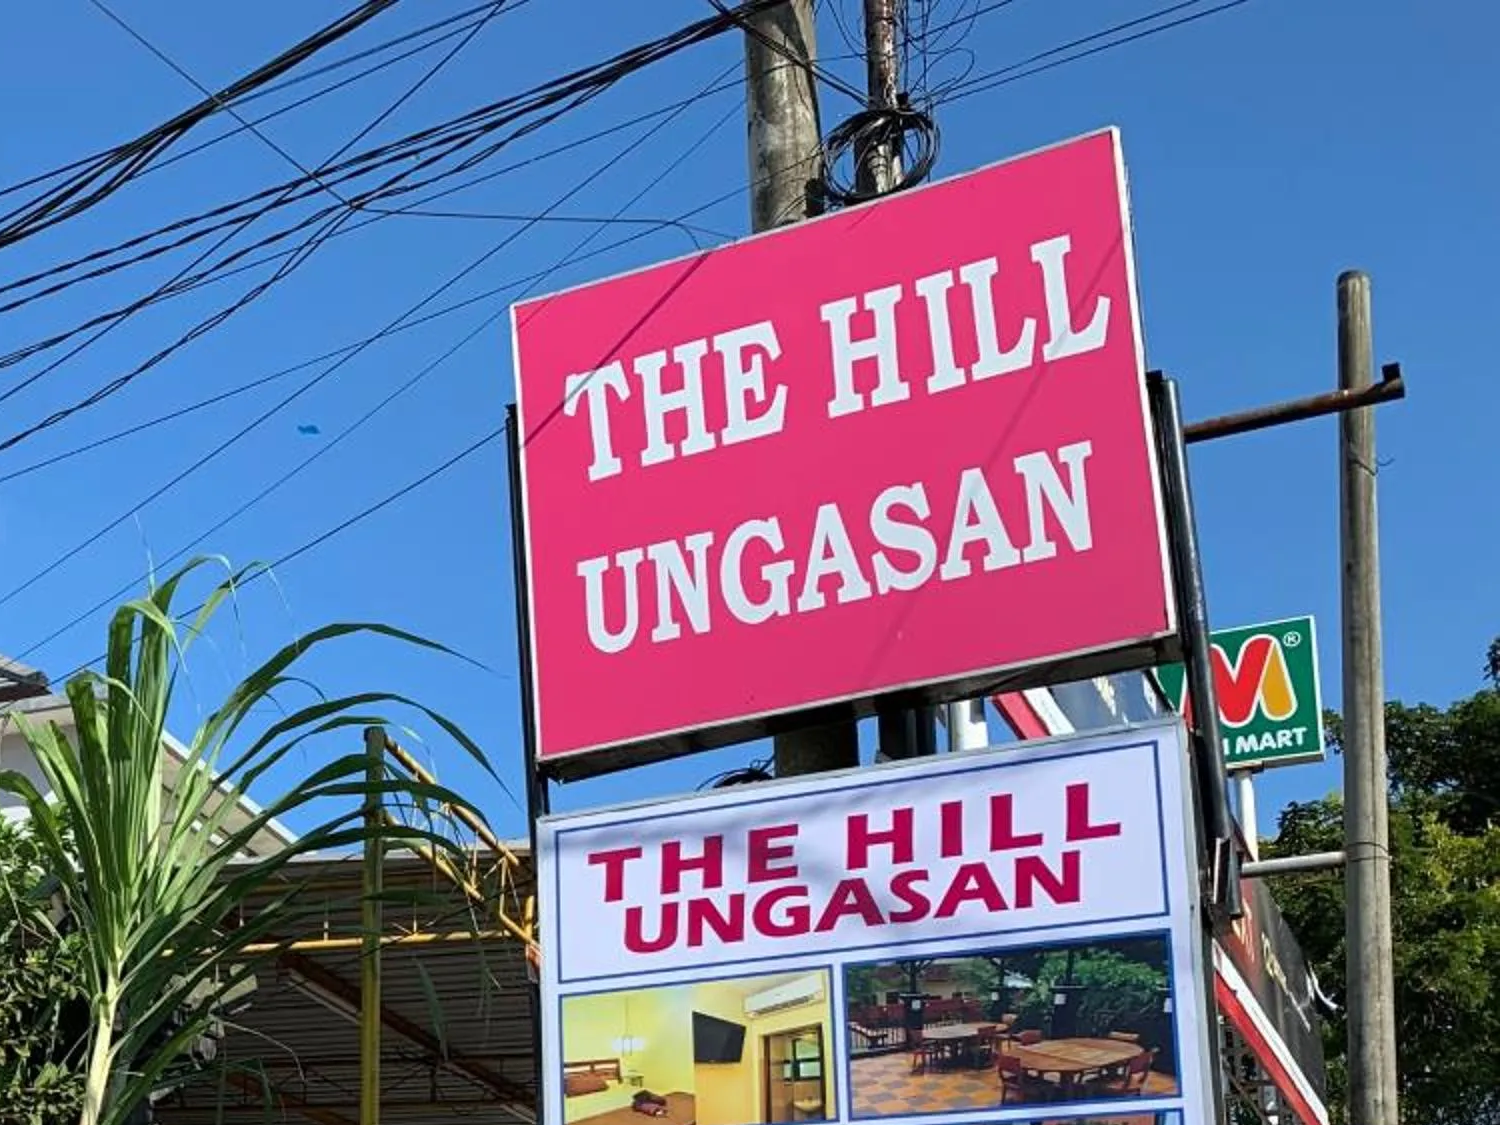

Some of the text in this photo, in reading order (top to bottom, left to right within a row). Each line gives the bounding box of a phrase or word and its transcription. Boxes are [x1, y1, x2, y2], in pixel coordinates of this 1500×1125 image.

[562, 234, 1111, 482] THE HILL
[577, 440, 1094, 654] UNGASAN
[1235, 726, 1308, 755] MART
[587, 782, 1122, 903] THE HILL
[623, 850, 1081, 954] UNGASAN
